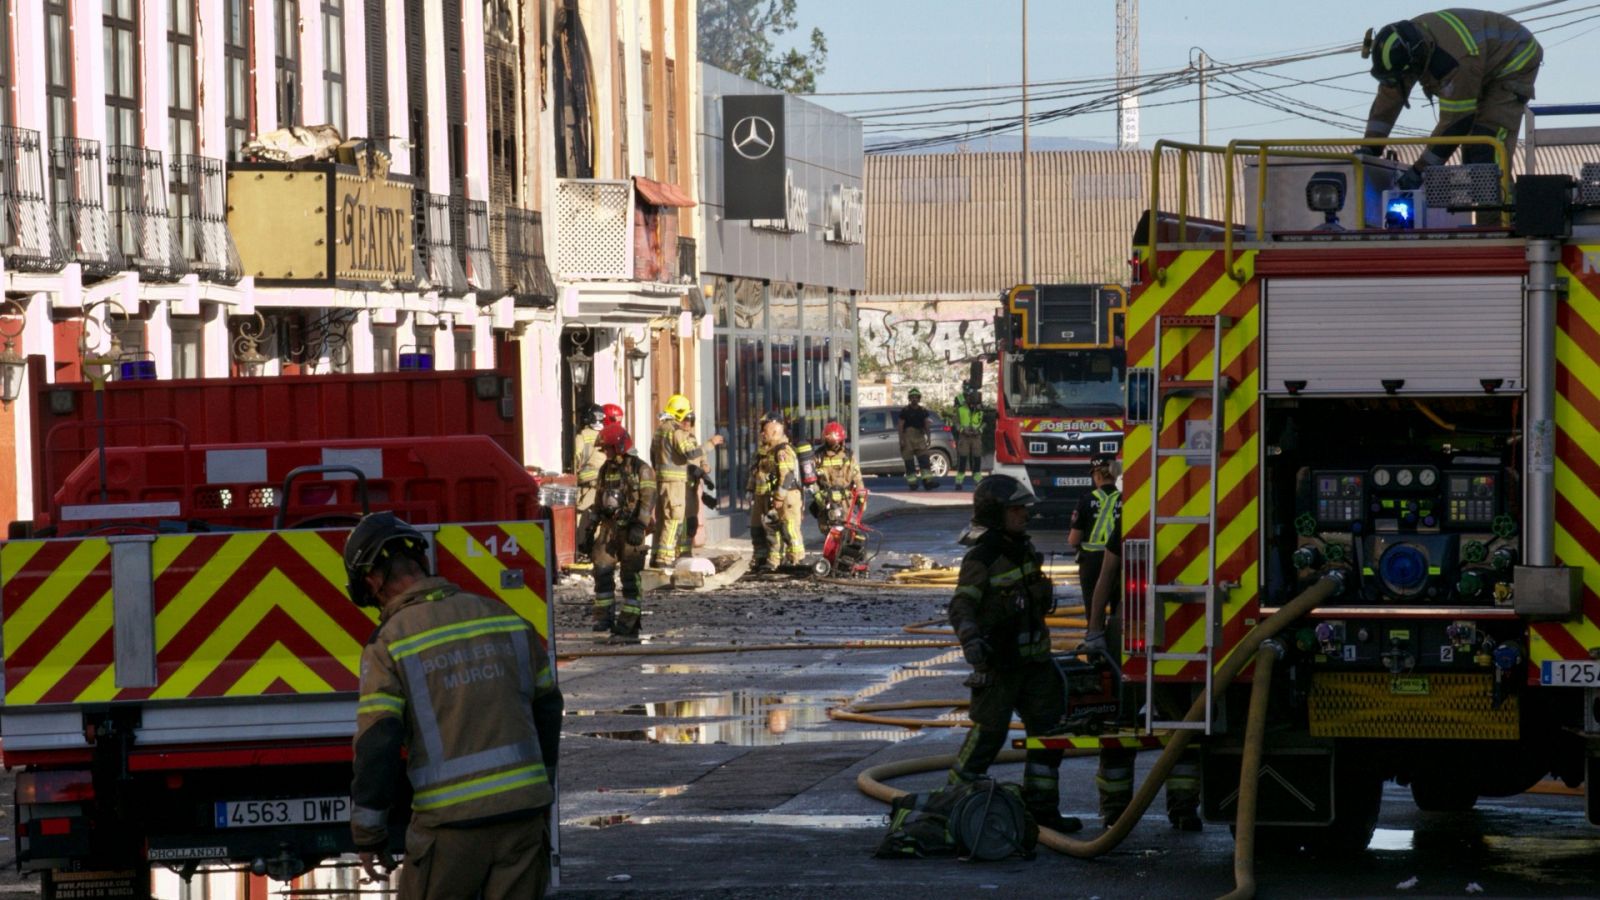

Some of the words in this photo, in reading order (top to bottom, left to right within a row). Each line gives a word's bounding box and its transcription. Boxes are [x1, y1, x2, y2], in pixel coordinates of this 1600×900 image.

[343, 186, 406, 275] TEATRE
[1056, 444, 1091, 452] MAN
[467, 534, 520, 557] L14
[232, 802, 289, 825] 4563
[303, 800, 346, 822] DWP
[149, 847, 226, 858] DHOLLANDIA
